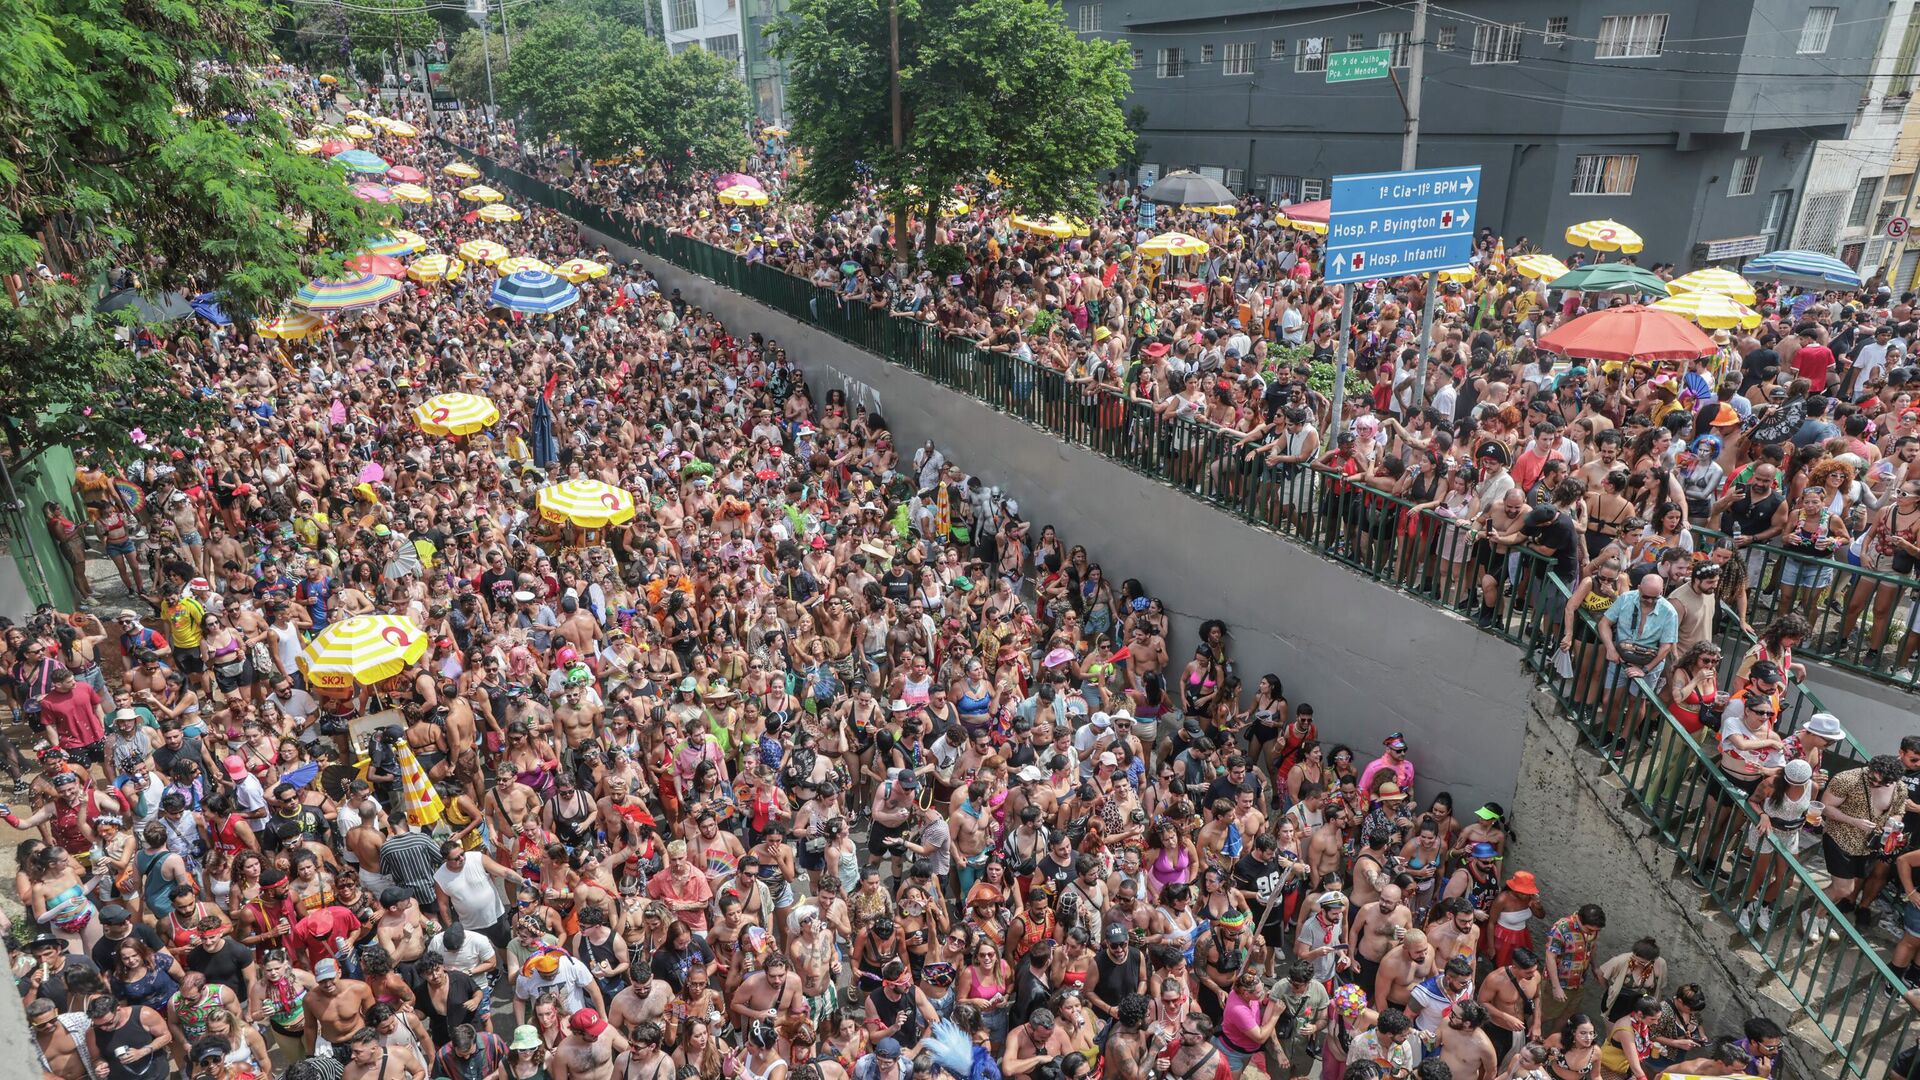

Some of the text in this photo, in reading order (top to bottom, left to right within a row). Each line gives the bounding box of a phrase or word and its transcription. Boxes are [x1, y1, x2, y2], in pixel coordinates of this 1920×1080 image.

[1329, 55, 1380, 67] Av. 9 de Julho
[1329, 67, 1378, 79] Pça. J. Mendes
[1434, 180, 1458, 195] BPM
[1334, 216, 1436, 237] Hosp. P. Byington
[1369, 246, 1446, 267] Hosp. Infantil
[321, 675, 345, 685] SKOL
